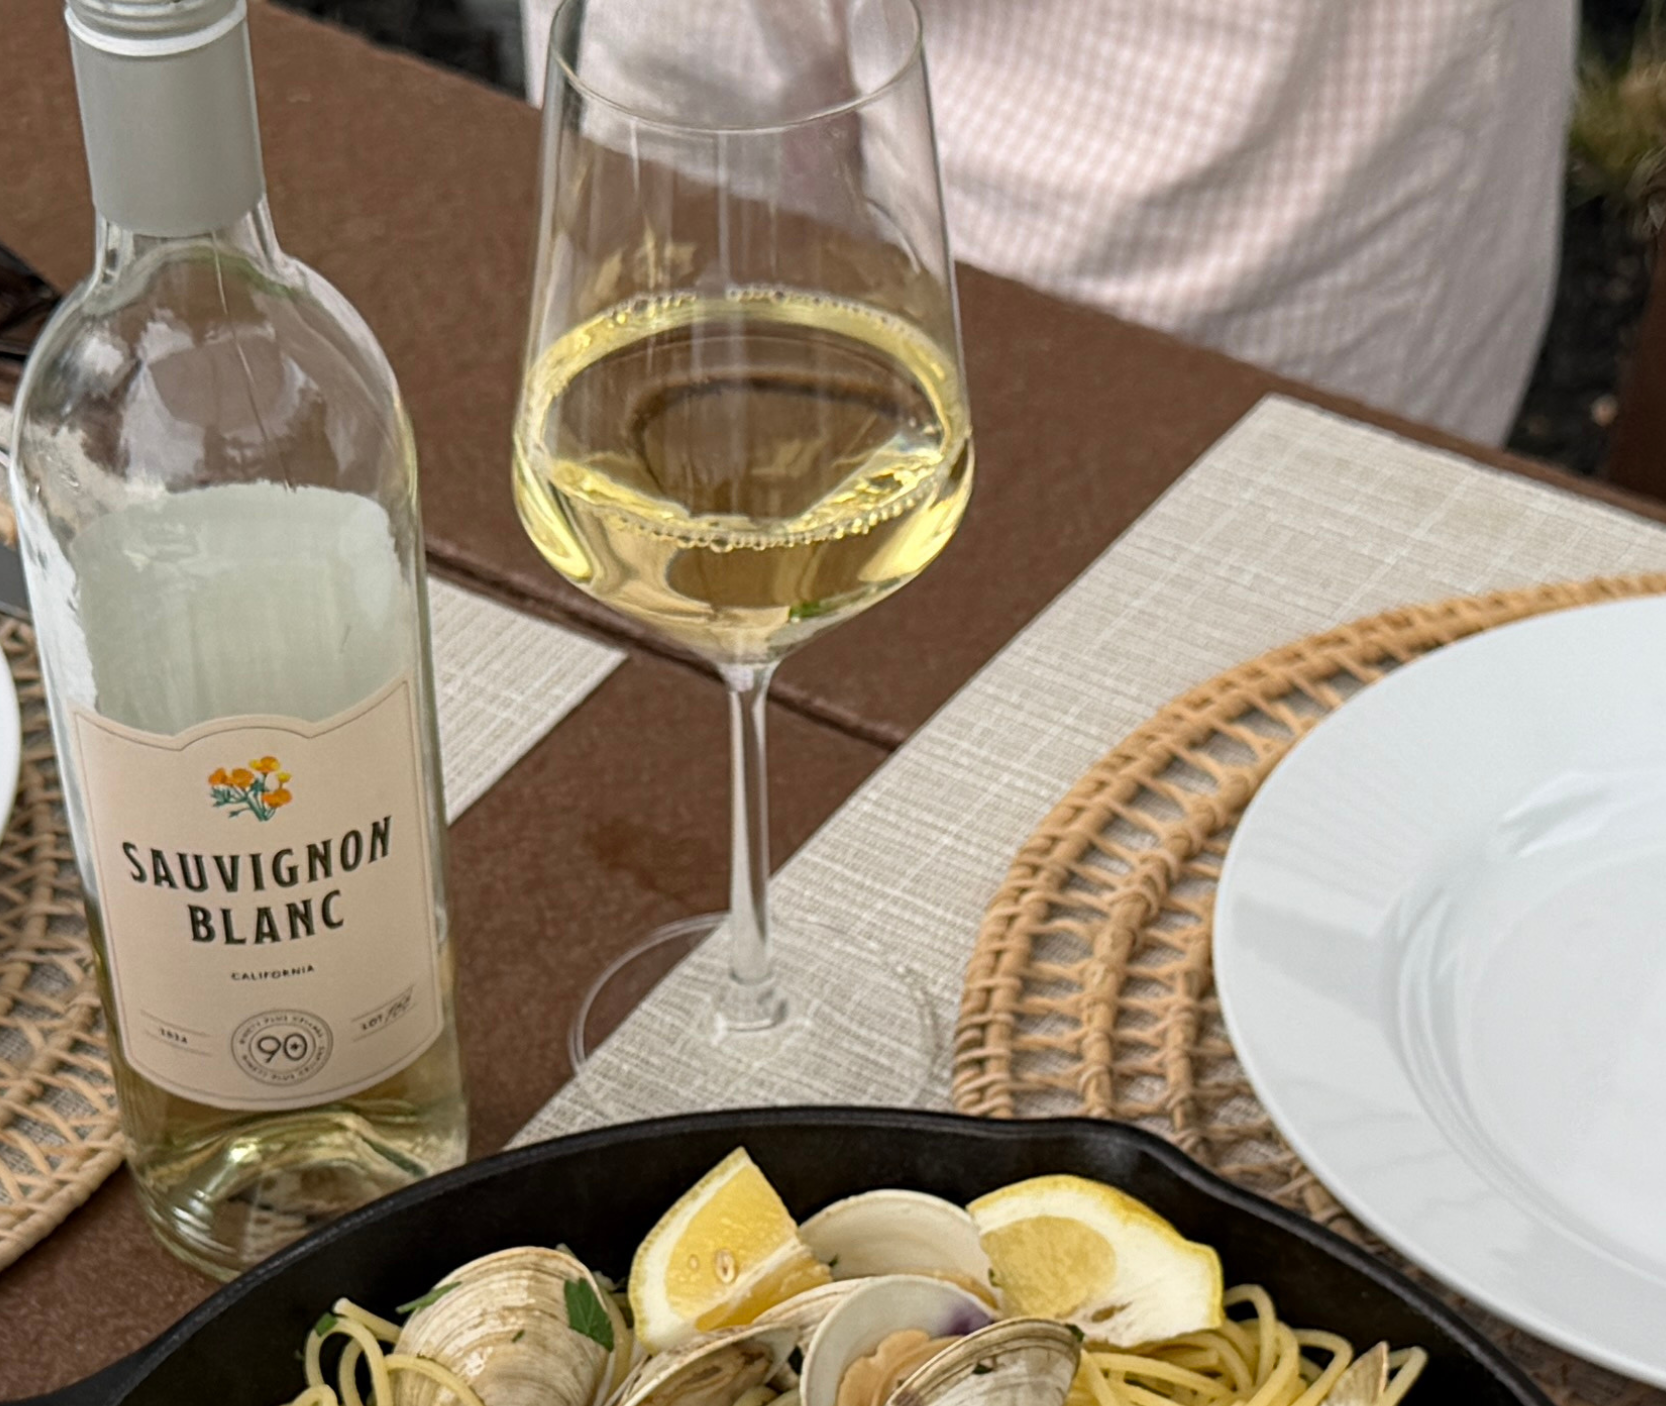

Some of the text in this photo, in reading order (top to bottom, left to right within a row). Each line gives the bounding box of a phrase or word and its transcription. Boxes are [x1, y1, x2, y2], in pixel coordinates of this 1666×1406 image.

[122, 816, 391, 892] SAUVIGNON
[188, 890, 345, 944] BLANC
[231, 964, 315, 981] CALIFORNIA
[256, 1032, 308, 1064] 90
